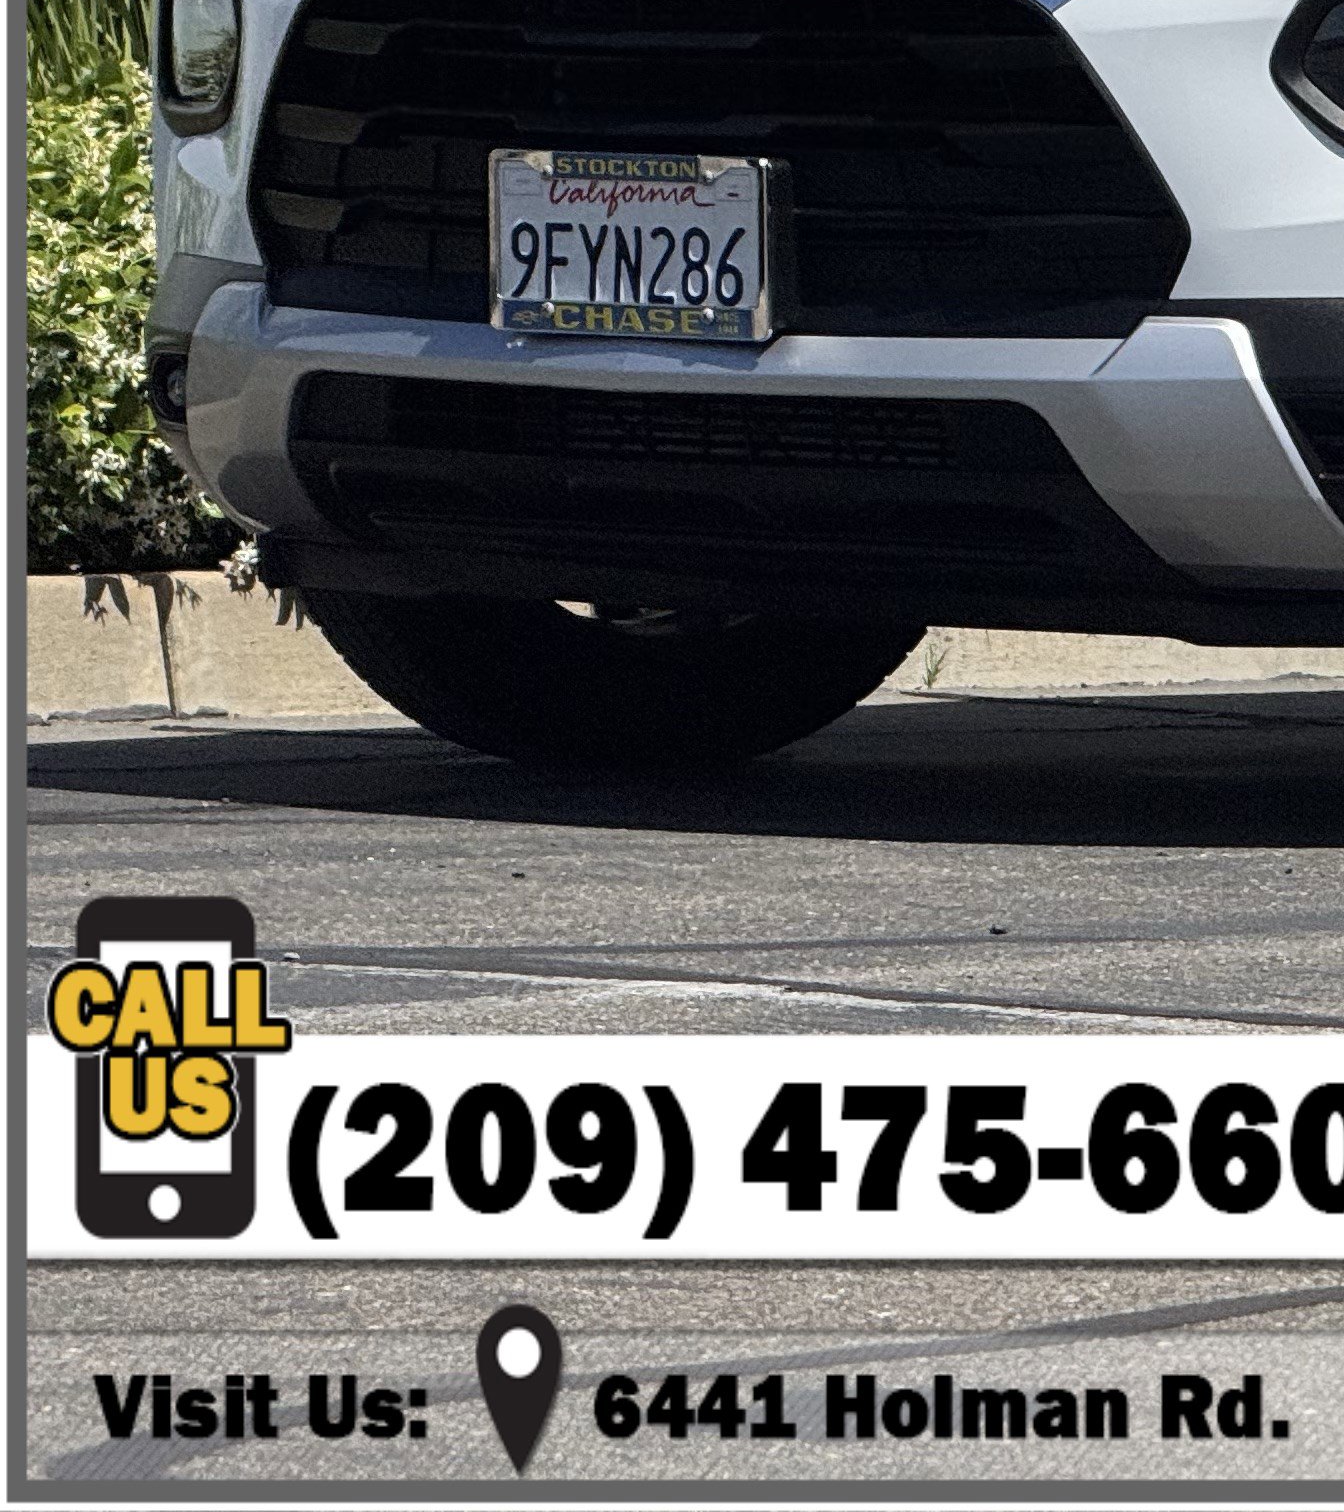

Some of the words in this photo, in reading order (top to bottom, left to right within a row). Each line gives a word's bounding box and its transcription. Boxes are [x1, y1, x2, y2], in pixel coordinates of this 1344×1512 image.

[556, 156, 696, 178] STOCKTON
[550, 178, 715, 219] California
[510, 220, 746, 307] 9FYN286
[553, 304, 702, 335] CHASE
